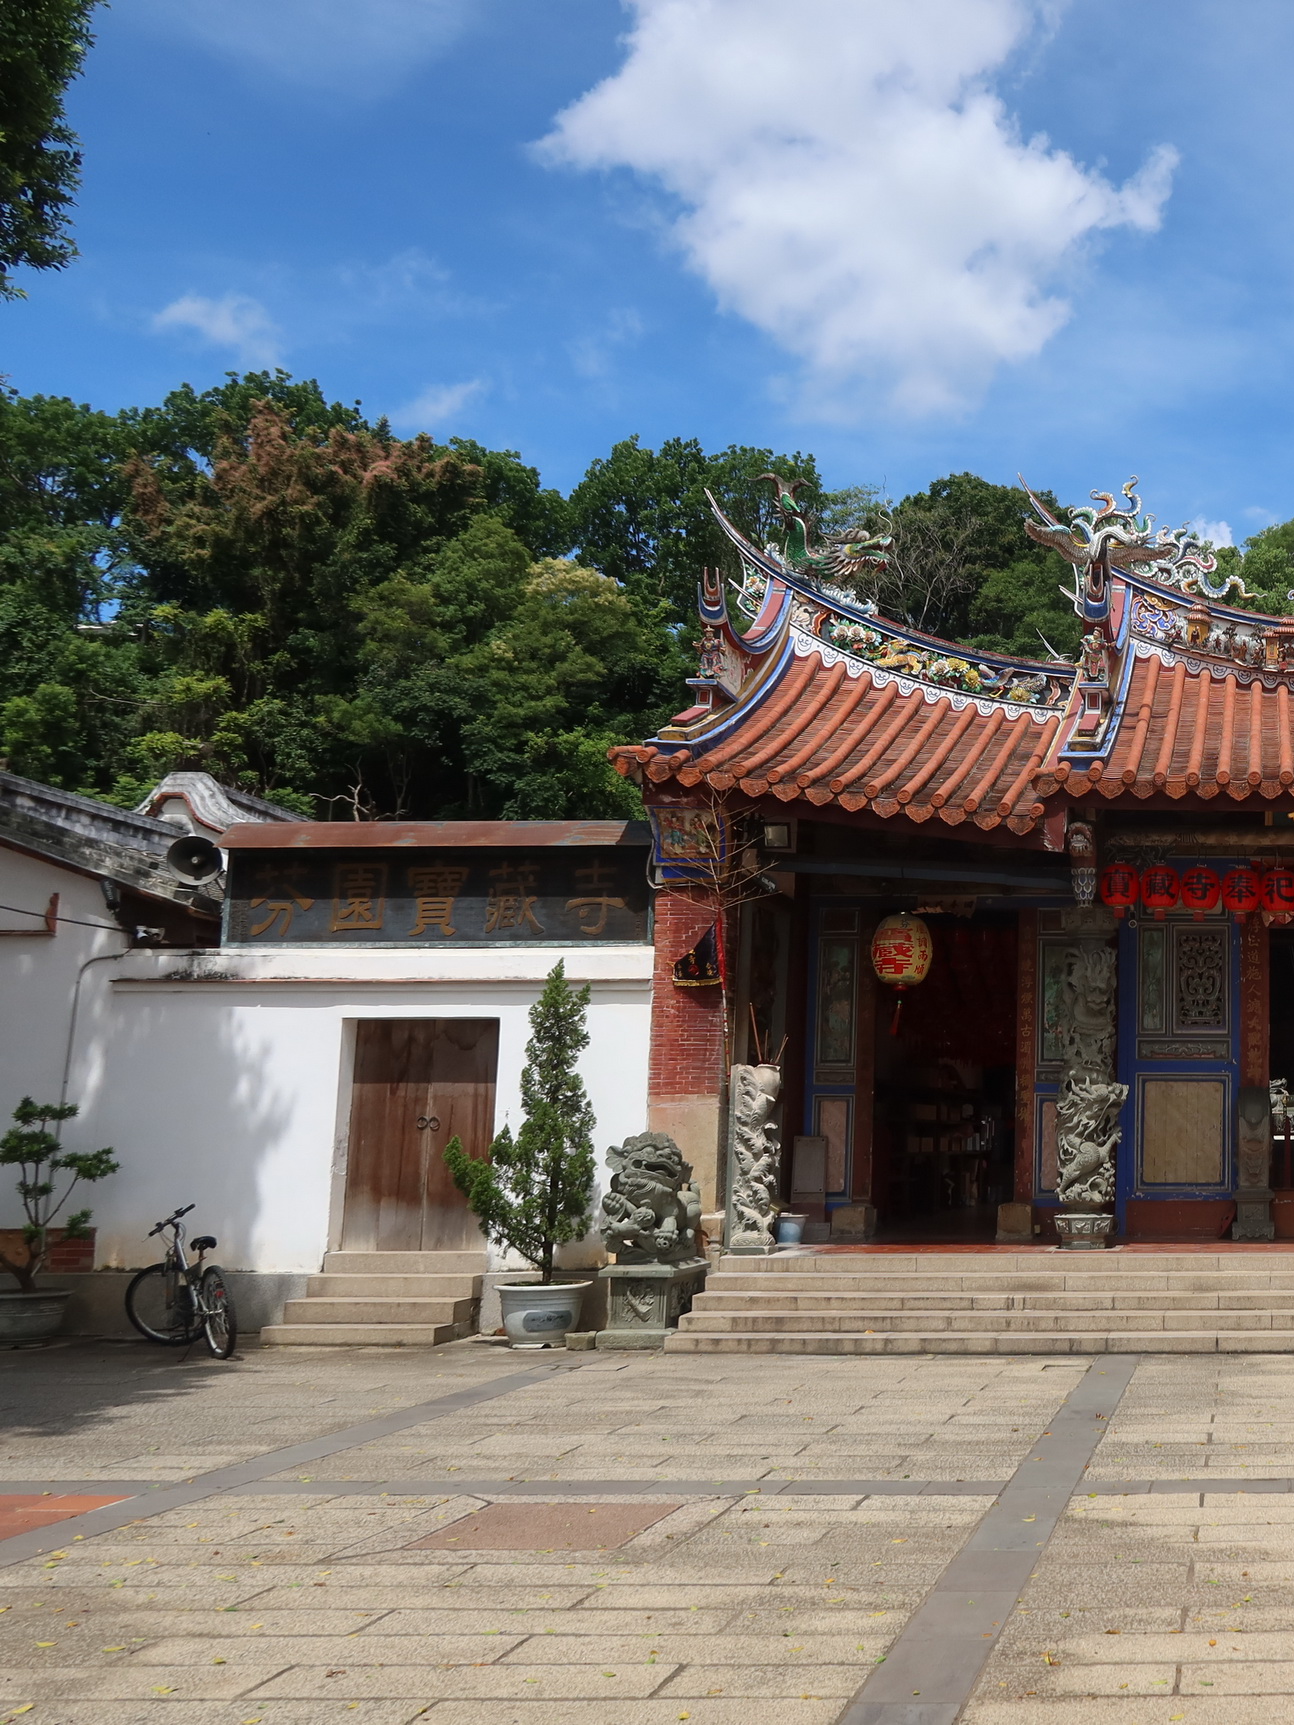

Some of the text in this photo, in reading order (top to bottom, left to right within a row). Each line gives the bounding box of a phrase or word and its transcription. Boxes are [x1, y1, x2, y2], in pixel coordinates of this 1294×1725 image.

[250, 859, 629, 937] 芬園寶藏寺
